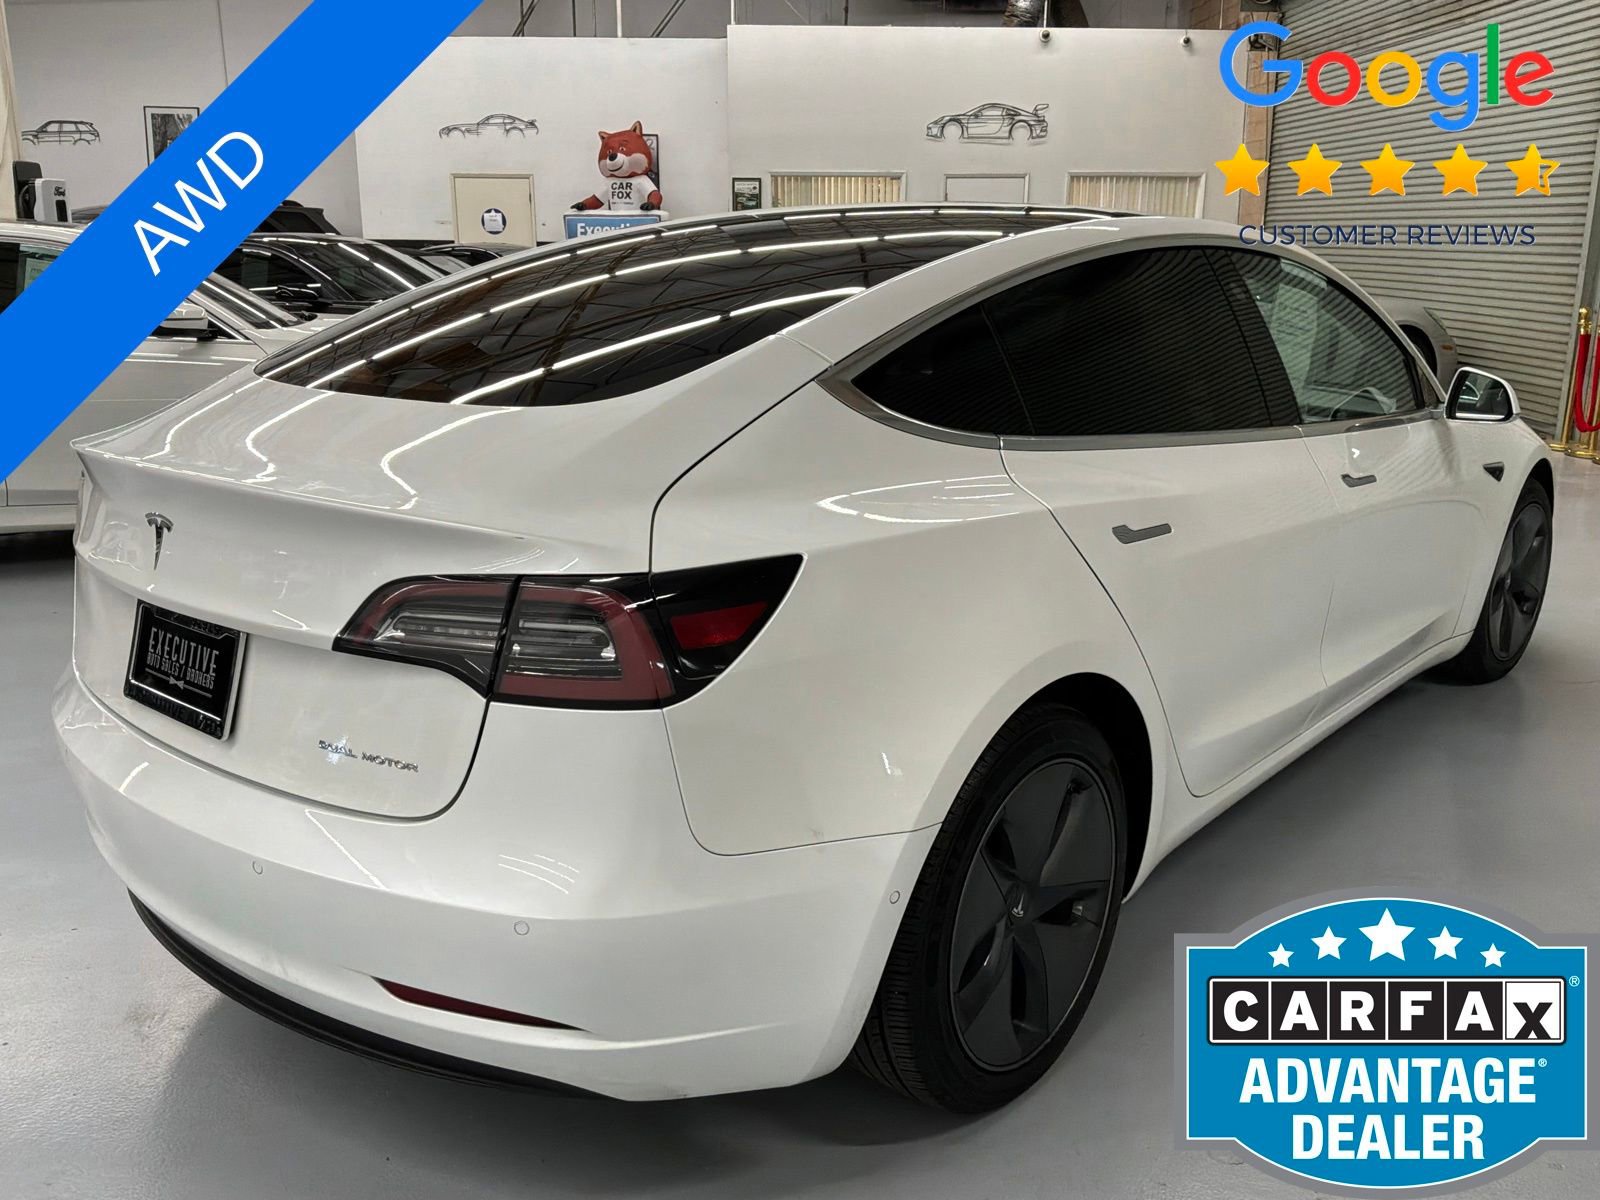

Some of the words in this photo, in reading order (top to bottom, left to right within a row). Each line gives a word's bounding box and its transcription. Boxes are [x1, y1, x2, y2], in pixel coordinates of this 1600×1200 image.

[611, 182, 633, 190] CAR
[611, 191, 632, 200] FOX
[148, 626, 220, 677] EXECUTIVE
[146, 651, 161, 669] AUTO
[161, 656, 180, 676] SALES
[186, 667, 215, 690] BROKERS
[362, 751, 419, 773] MOTOR
